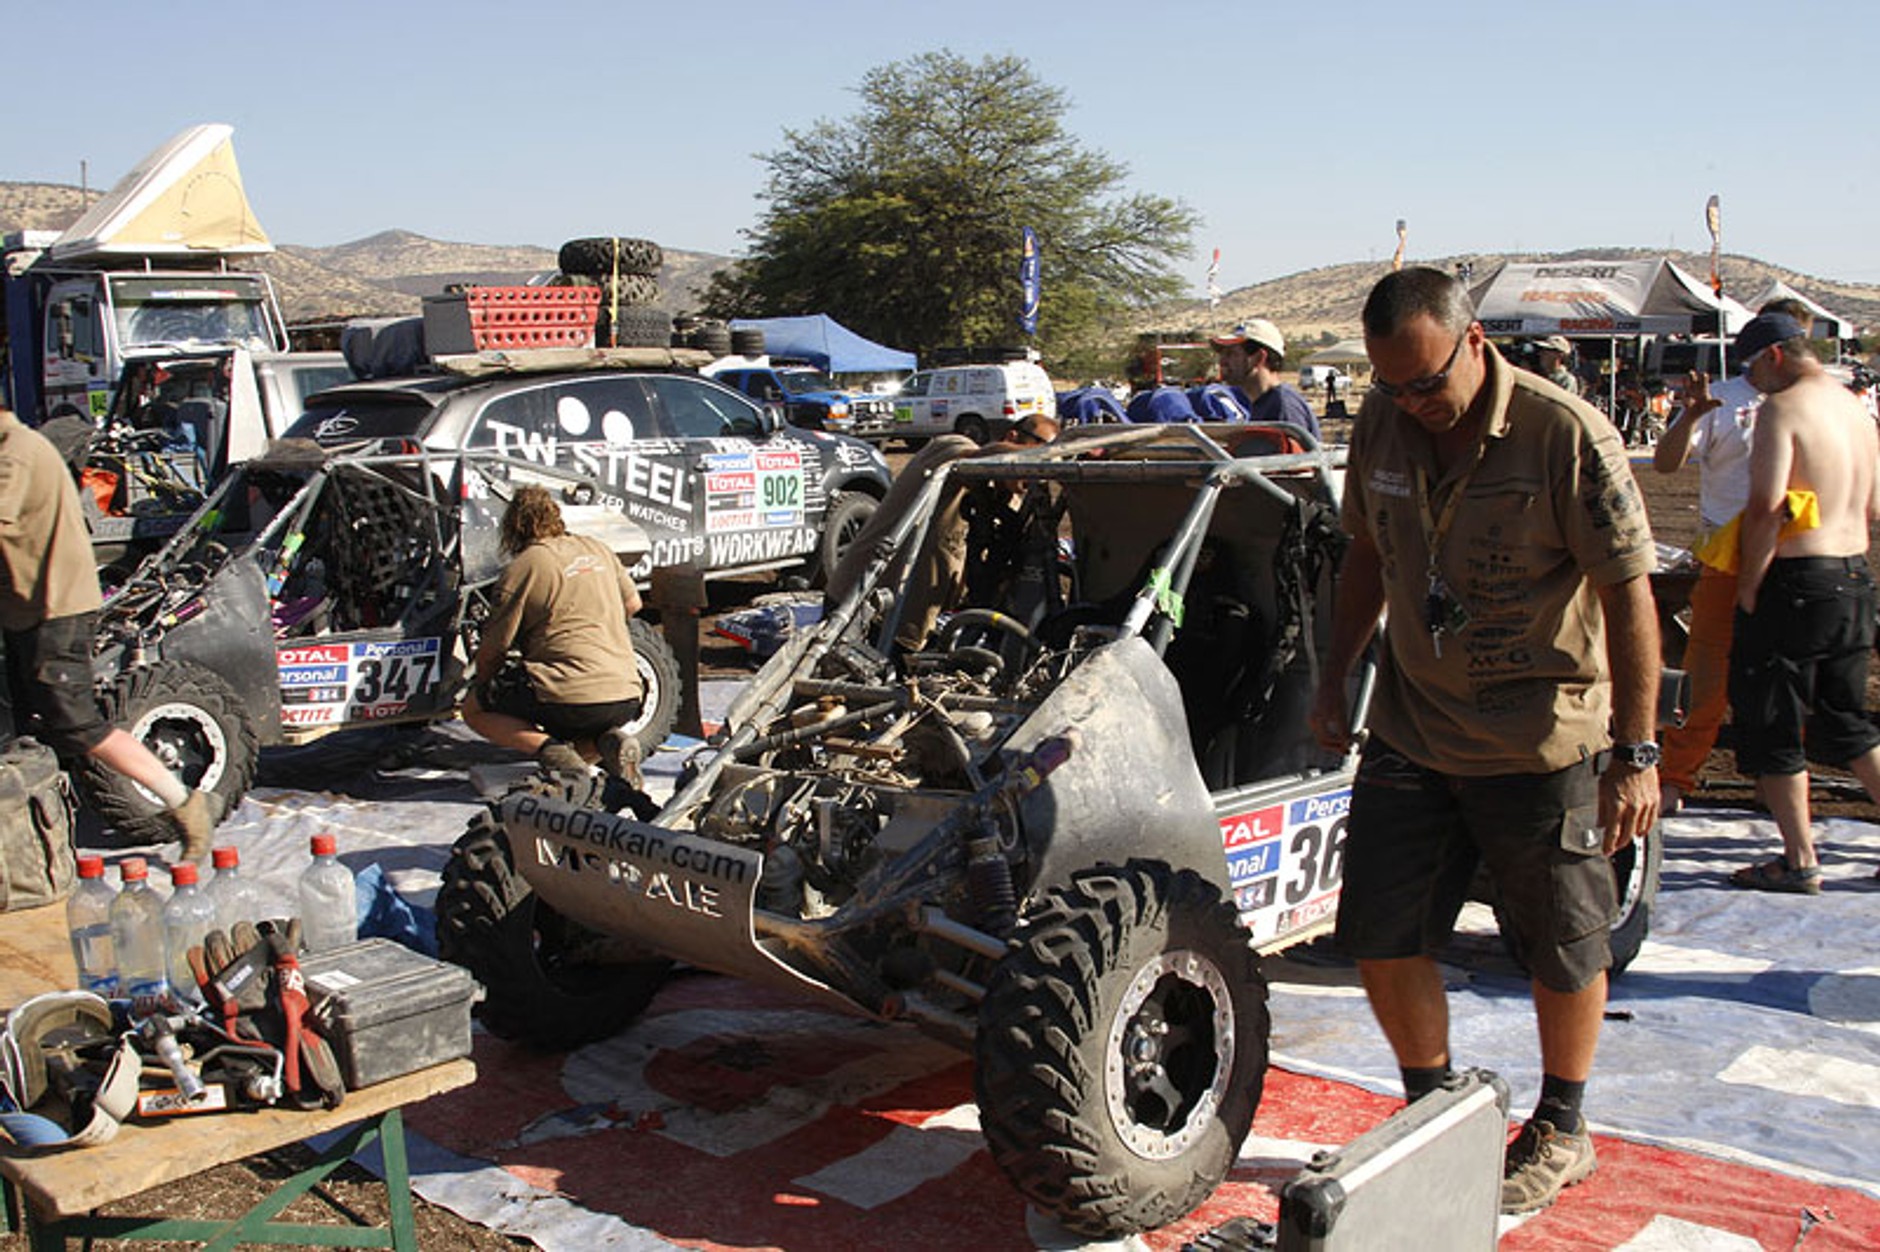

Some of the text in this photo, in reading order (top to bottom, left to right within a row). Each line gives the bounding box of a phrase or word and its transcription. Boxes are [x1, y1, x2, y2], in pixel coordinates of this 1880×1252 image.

[486, 420, 693, 512] TW STEEL
[763, 475, 799, 507] 902
[629, 502, 688, 532] WATCHES
[709, 528, 818, 566] WORKWEAR
[279, 650, 338, 663] OTAL
[278, 667, 338, 683] ersonal
[355, 655, 436, 704] 347
[514, 796, 747, 883] ProDakar.com
[1220, 818, 1271, 845] TAL
[1285, 815, 1349, 905] 36
